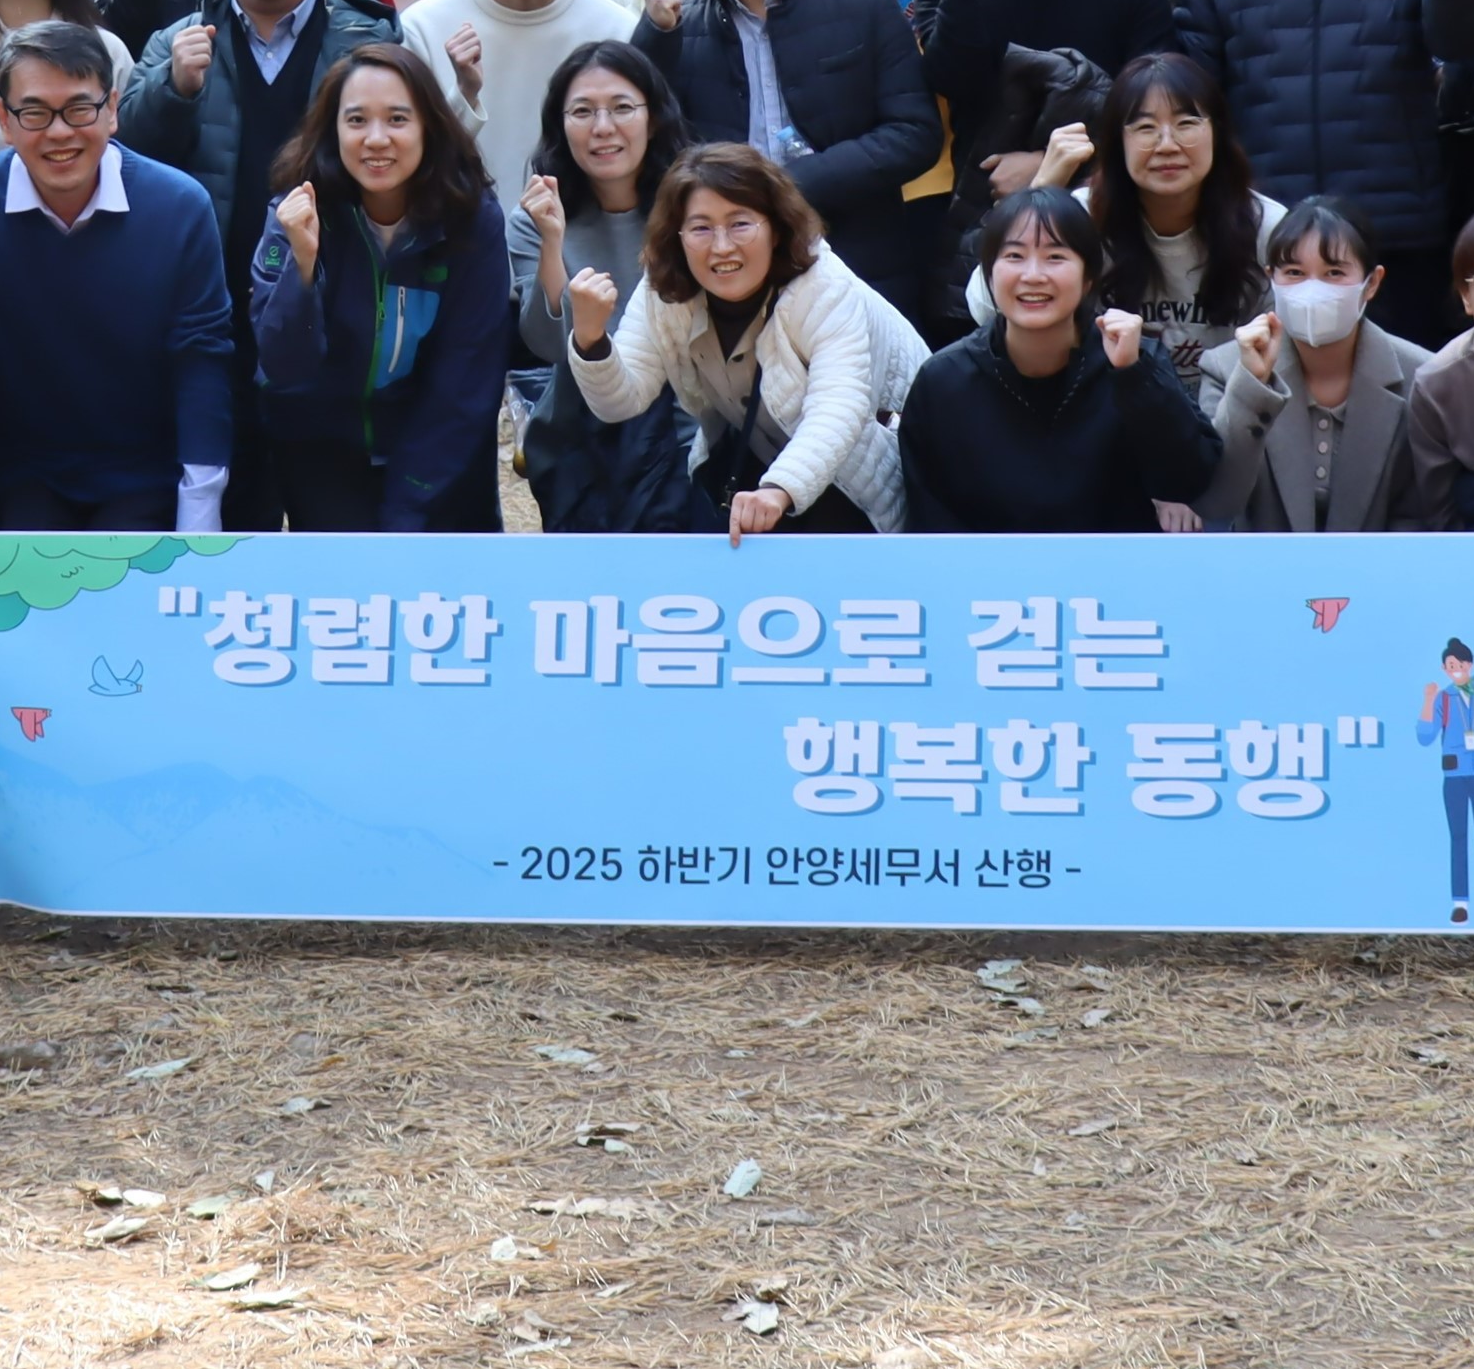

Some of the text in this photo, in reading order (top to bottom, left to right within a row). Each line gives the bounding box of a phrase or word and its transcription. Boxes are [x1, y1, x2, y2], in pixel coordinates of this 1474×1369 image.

[158, 586, 1167, 691] "청렴한 마음으로 걷는
[784, 717, 1382, 820] 행복한 동행"
[521, 846, 623, 881] 2025
[638, 845, 750, 884] 하반기
[766, 847, 959, 888] 안양세무서
[975, 849, 1051, 889] 산행
